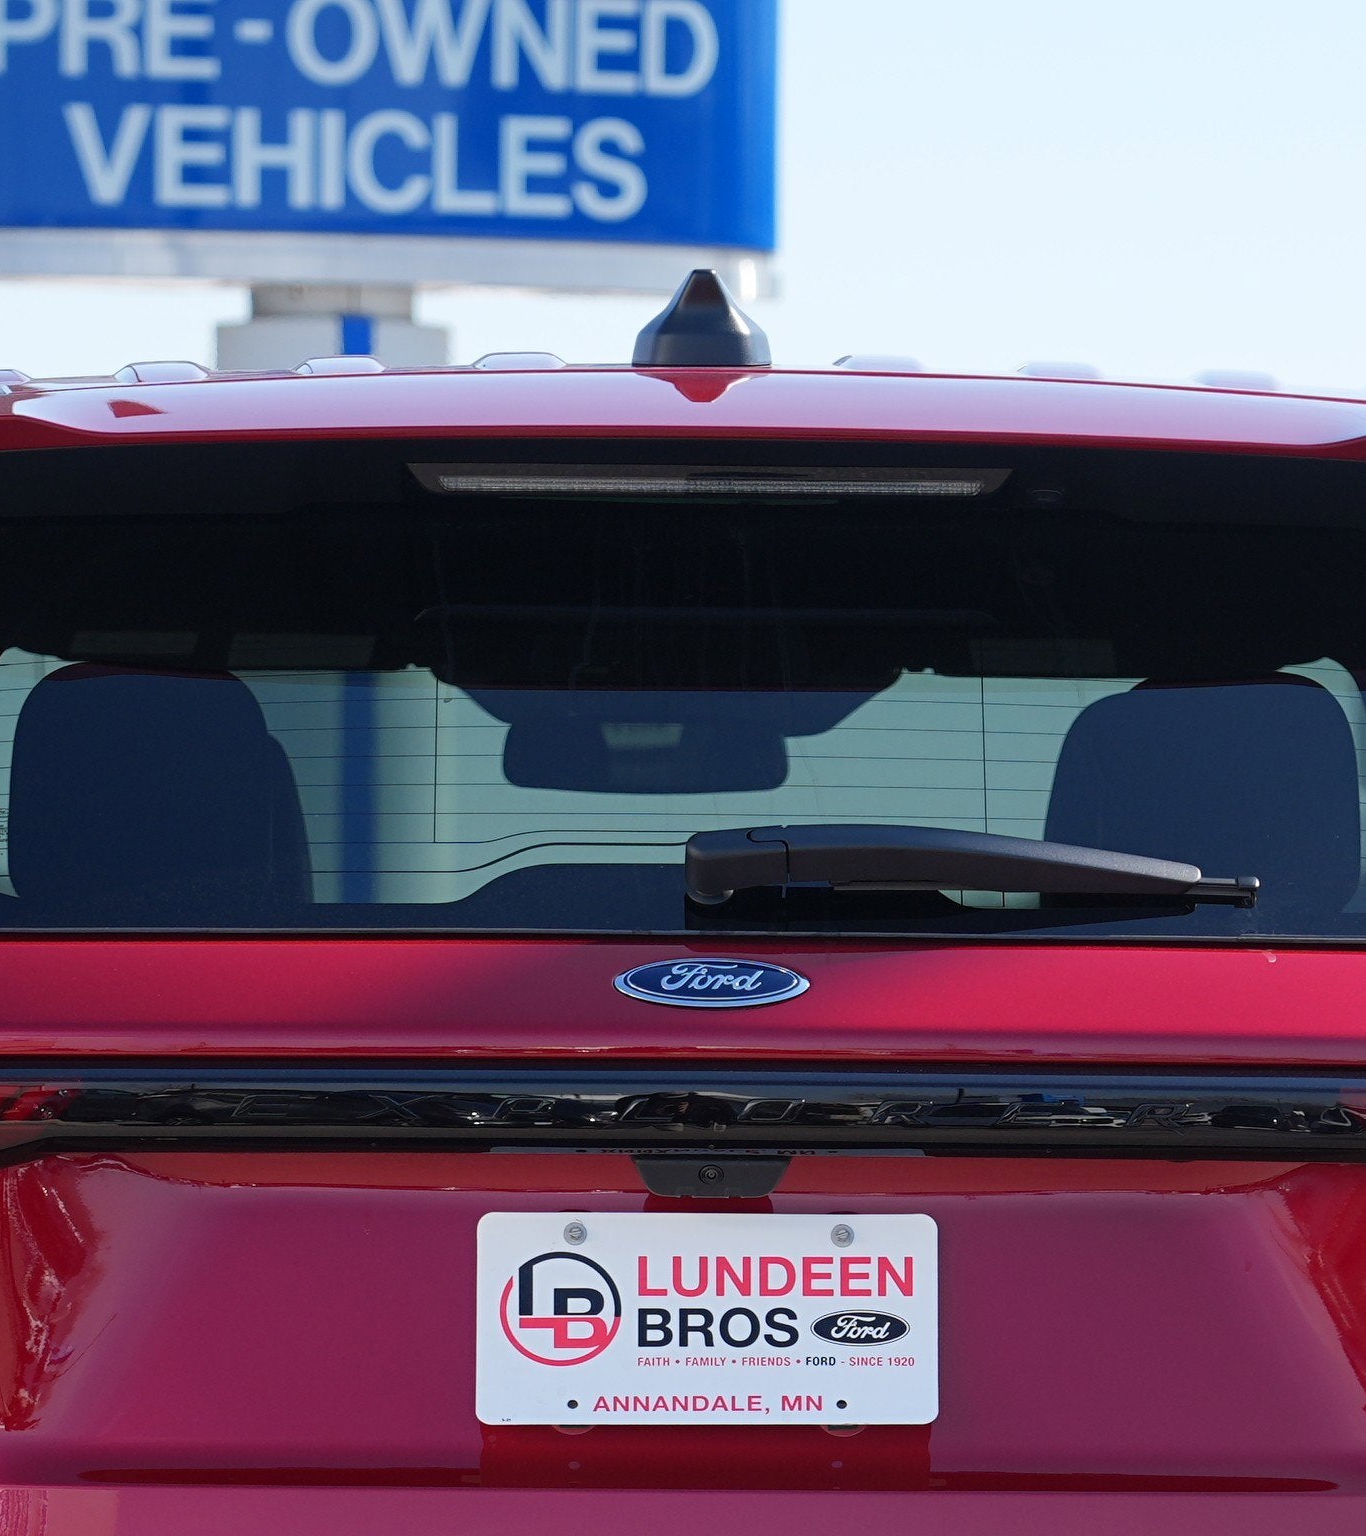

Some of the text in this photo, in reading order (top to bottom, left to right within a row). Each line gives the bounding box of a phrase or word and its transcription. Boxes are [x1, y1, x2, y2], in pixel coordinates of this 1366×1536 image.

[60, 101, 649, 223] VEHICLES
[660, 963, 765, 991] Ford
[637, 1255, 914, 1298] LUNDEEN
[637, 1306, 892, 1349] BROS Ford
[637, 1356, 916, 1367] FAITH FAMILY FRIENDS FORD SINCE 1920
[592, 1395, 823, 1415] ANNANDALE, MN
